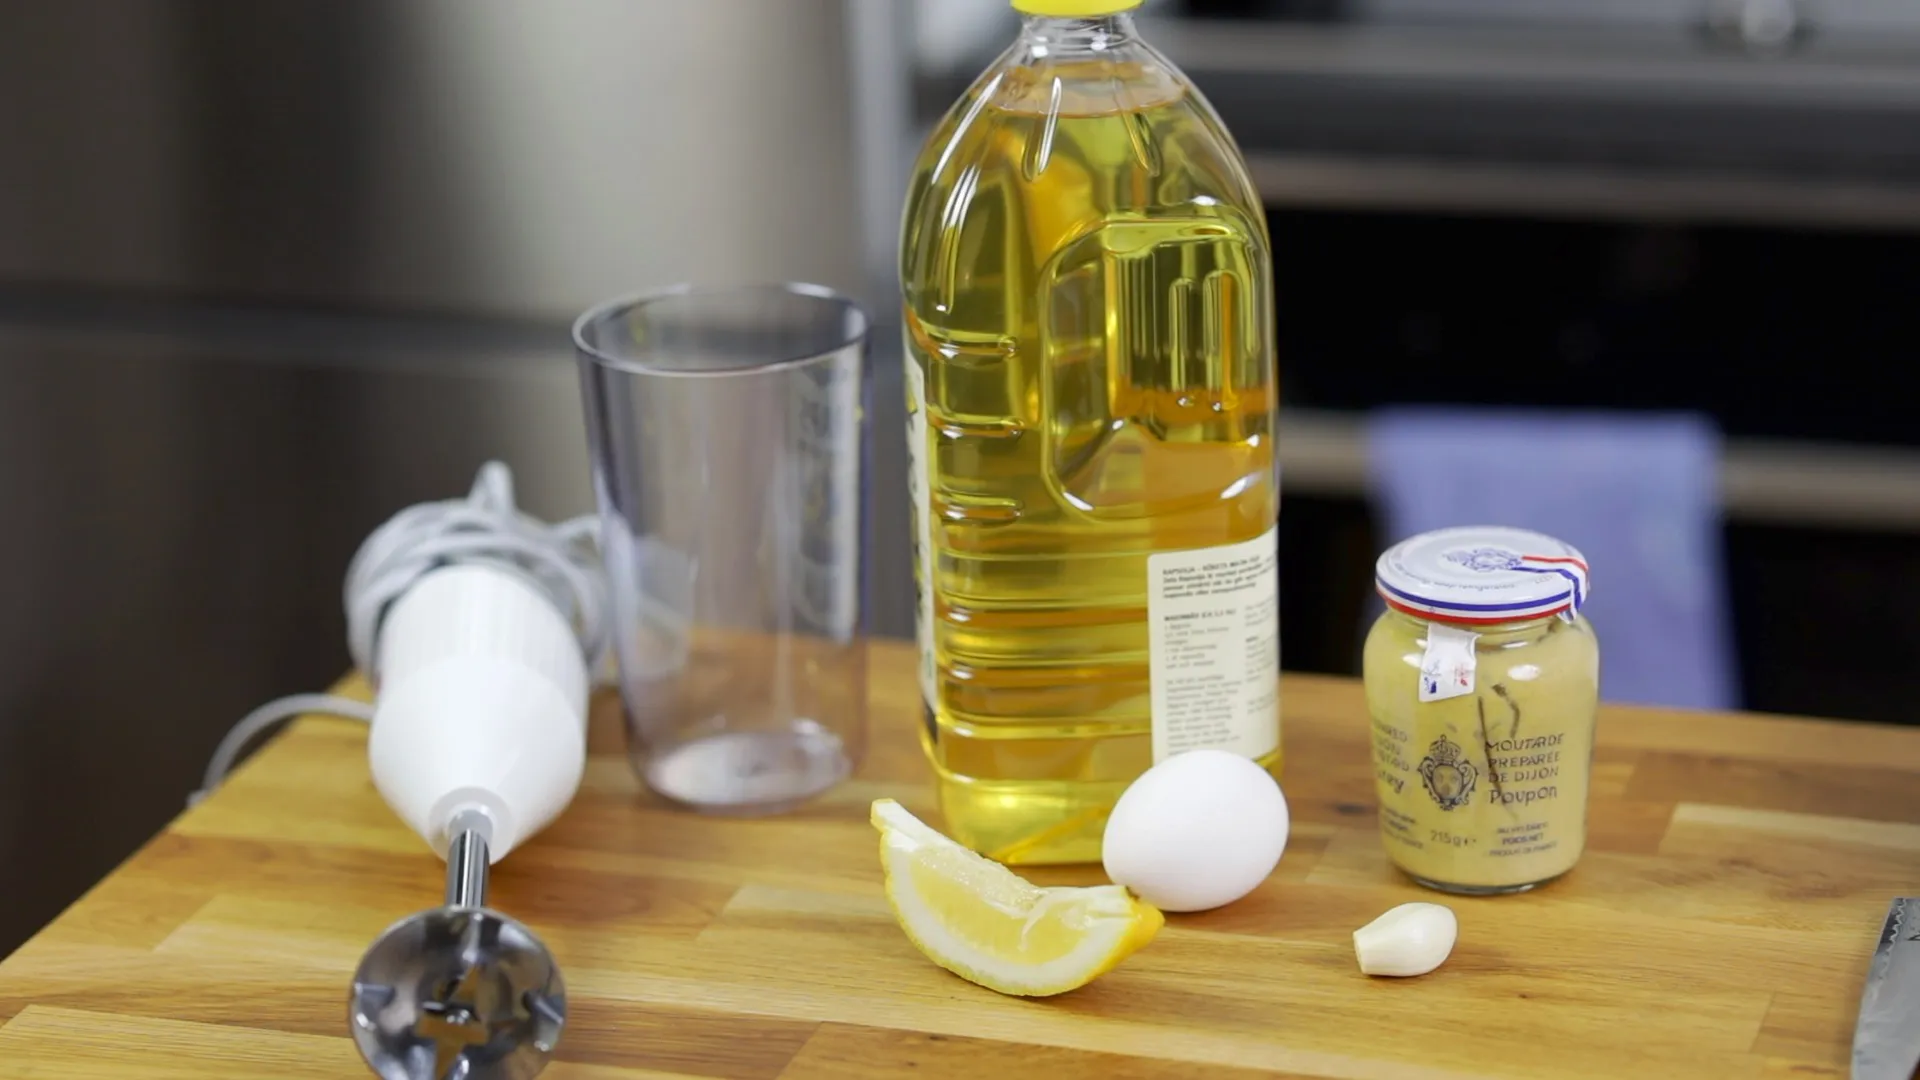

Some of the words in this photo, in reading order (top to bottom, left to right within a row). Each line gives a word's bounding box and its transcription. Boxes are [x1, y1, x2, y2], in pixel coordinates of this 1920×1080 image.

[1485, 733, 1564, 752] MOUTARDE
[1489, 772, 1508, 783] DE
[1514, 766, 1559, 782] DIJON
[1487, 786, 1557, 806] Poupon
